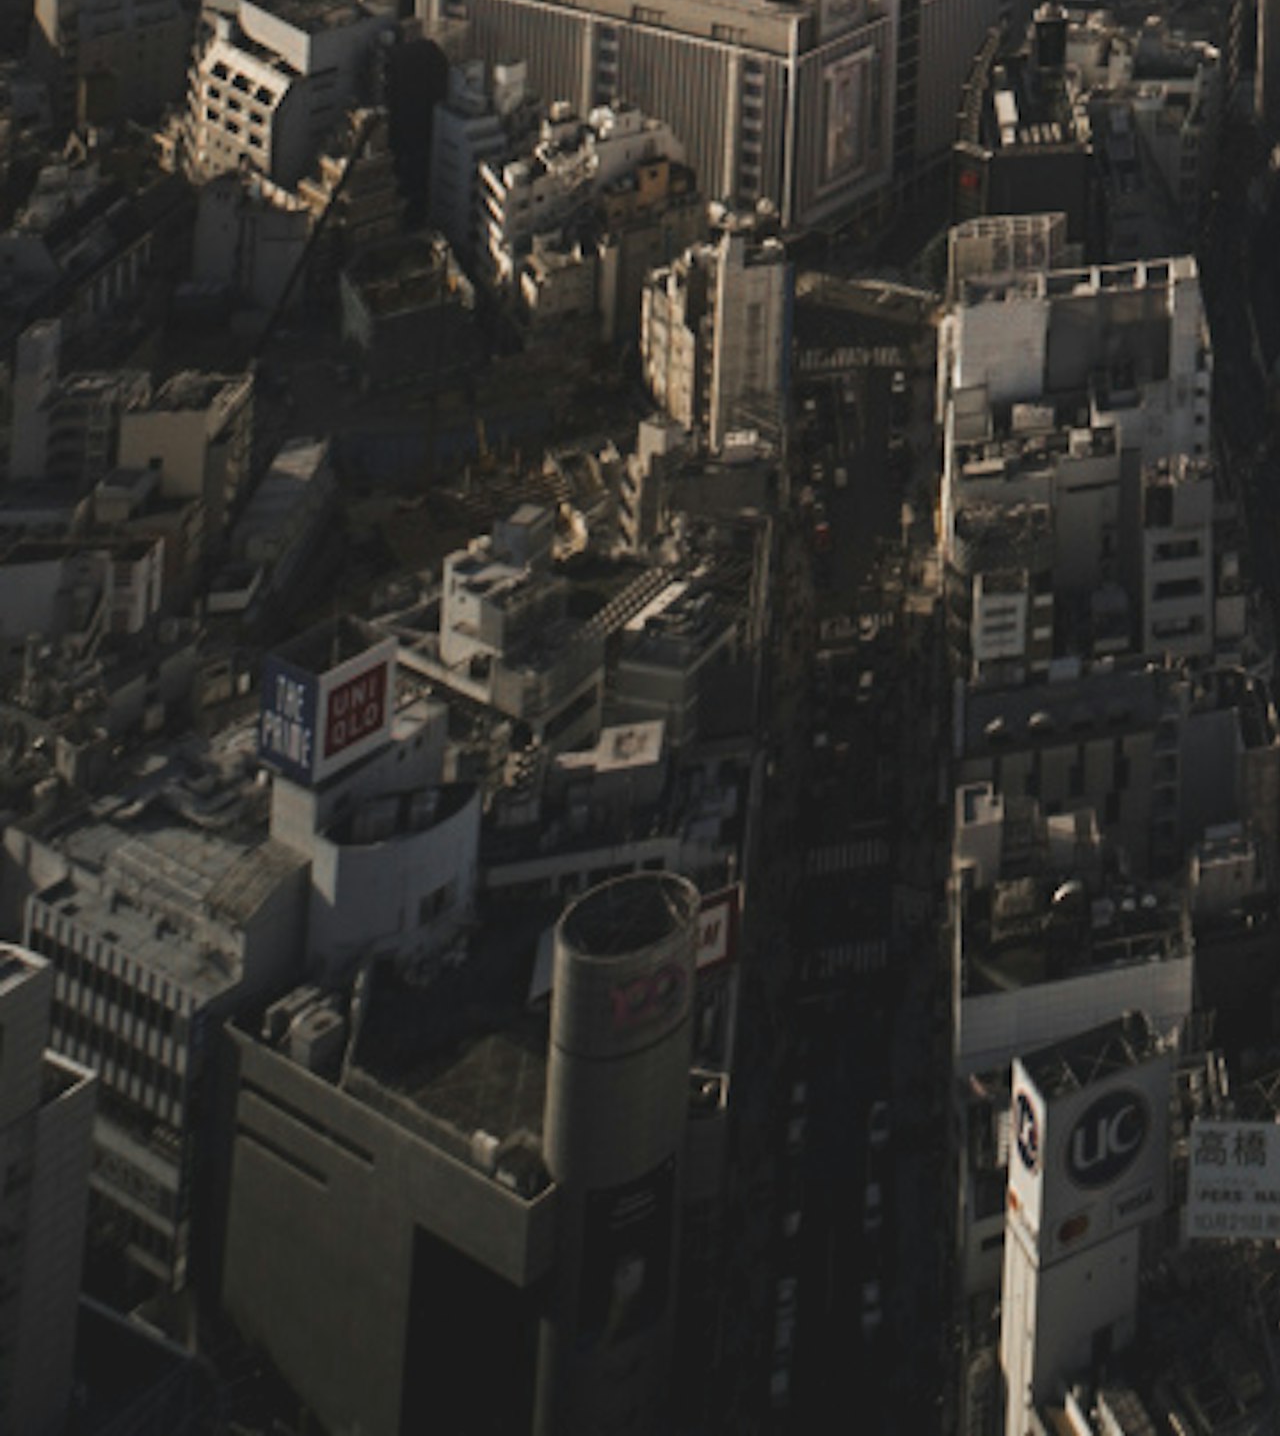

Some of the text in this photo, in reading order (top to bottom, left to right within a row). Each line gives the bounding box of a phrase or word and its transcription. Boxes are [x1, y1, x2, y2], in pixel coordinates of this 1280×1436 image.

[275, 673, 305, 723] THE
[333, 675, 379, 718] UNI
[331, 701, 380, 746] QLO
[1073, 1104, 1144, 1172] UC
[1195, 1129, 1266, 1167] 高橋
